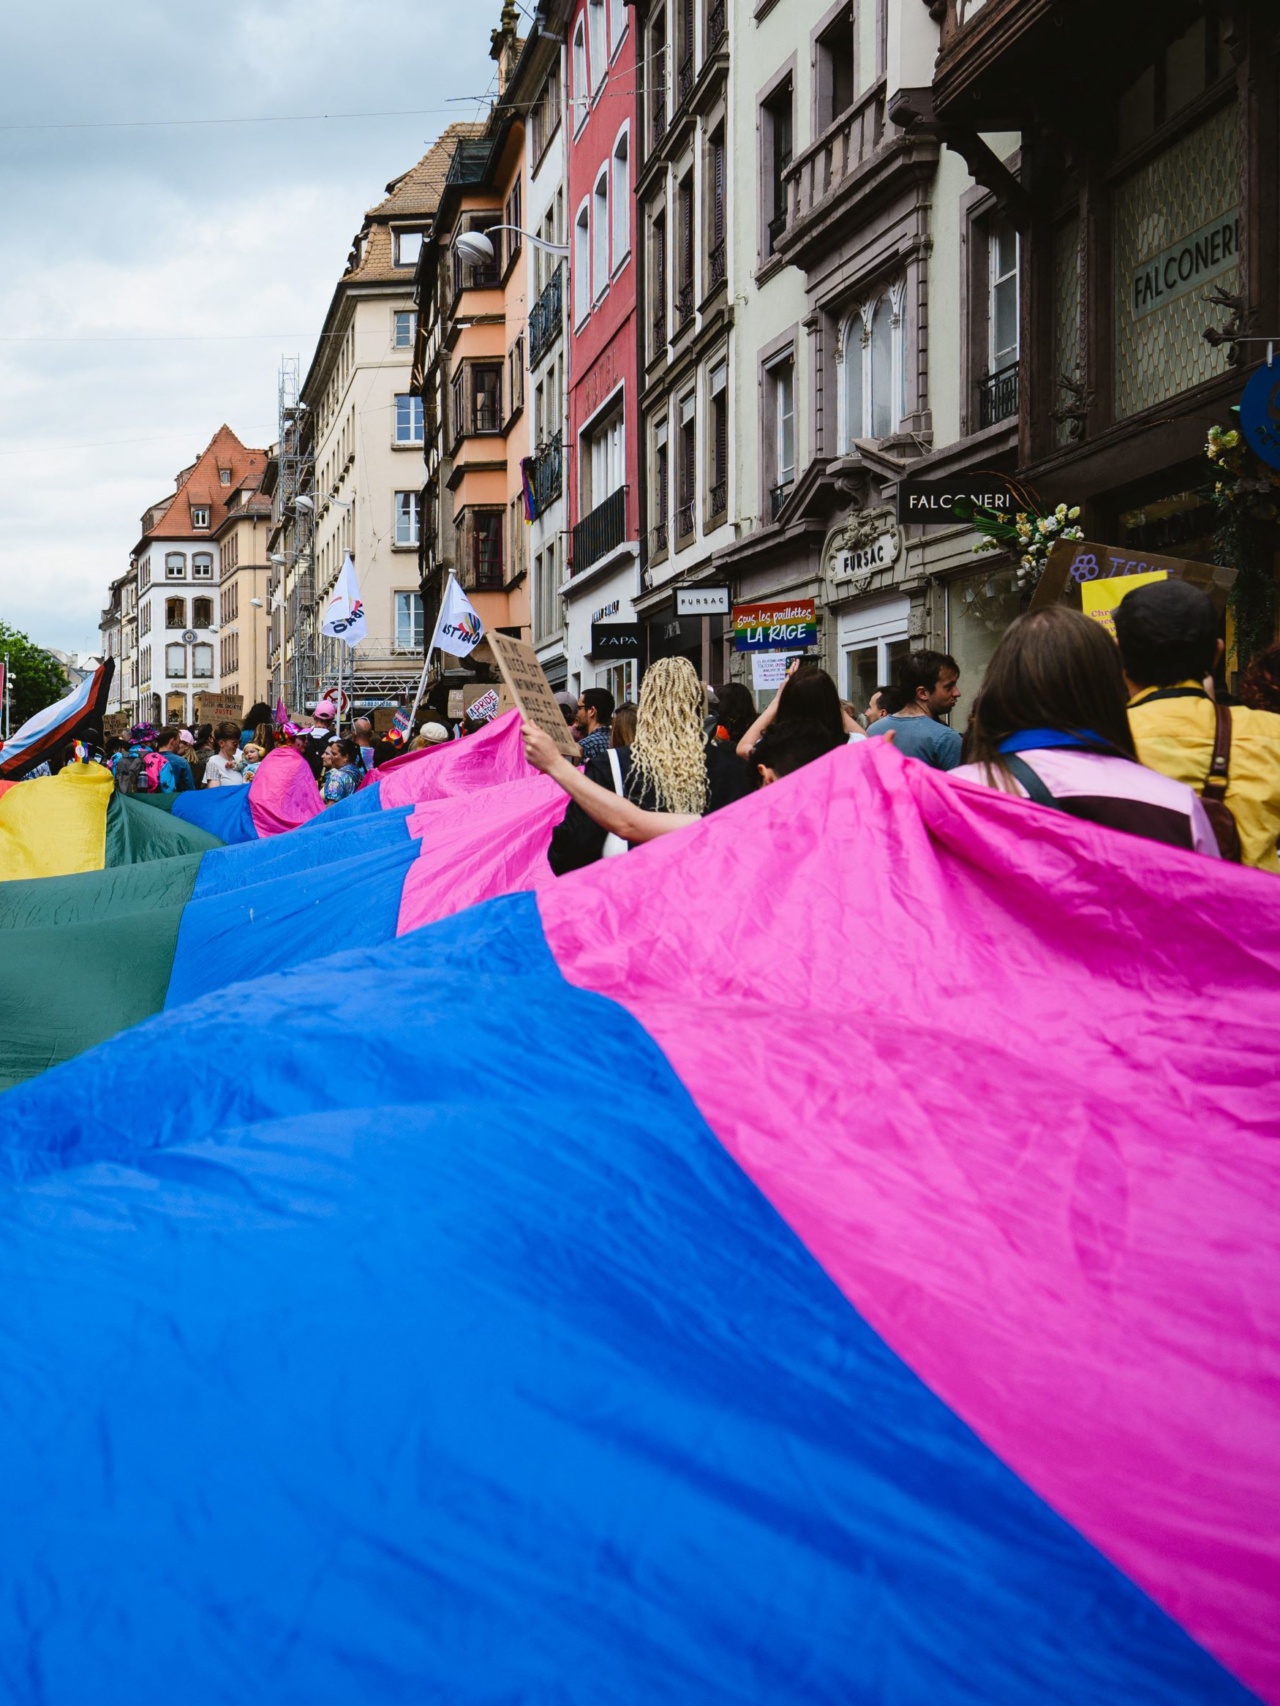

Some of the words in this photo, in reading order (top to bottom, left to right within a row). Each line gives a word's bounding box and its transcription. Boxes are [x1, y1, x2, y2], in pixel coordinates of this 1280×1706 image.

[1135, 218, 1239, 309] FALCONERI
[843, 545, 884, 573] FURSAC
[681, 597, 724, 605] FURSAC
[737, 614, 756, 628] sous
[759, 610, 770, 624] les
[773, 607, 811, 624] paillettes
[599, 636, 638, 646] ZAPA
[747, 626, 763, 643] LA
[768, 623, 807, 642] RAGE
[473, 691, 497, 713] PRIDE
